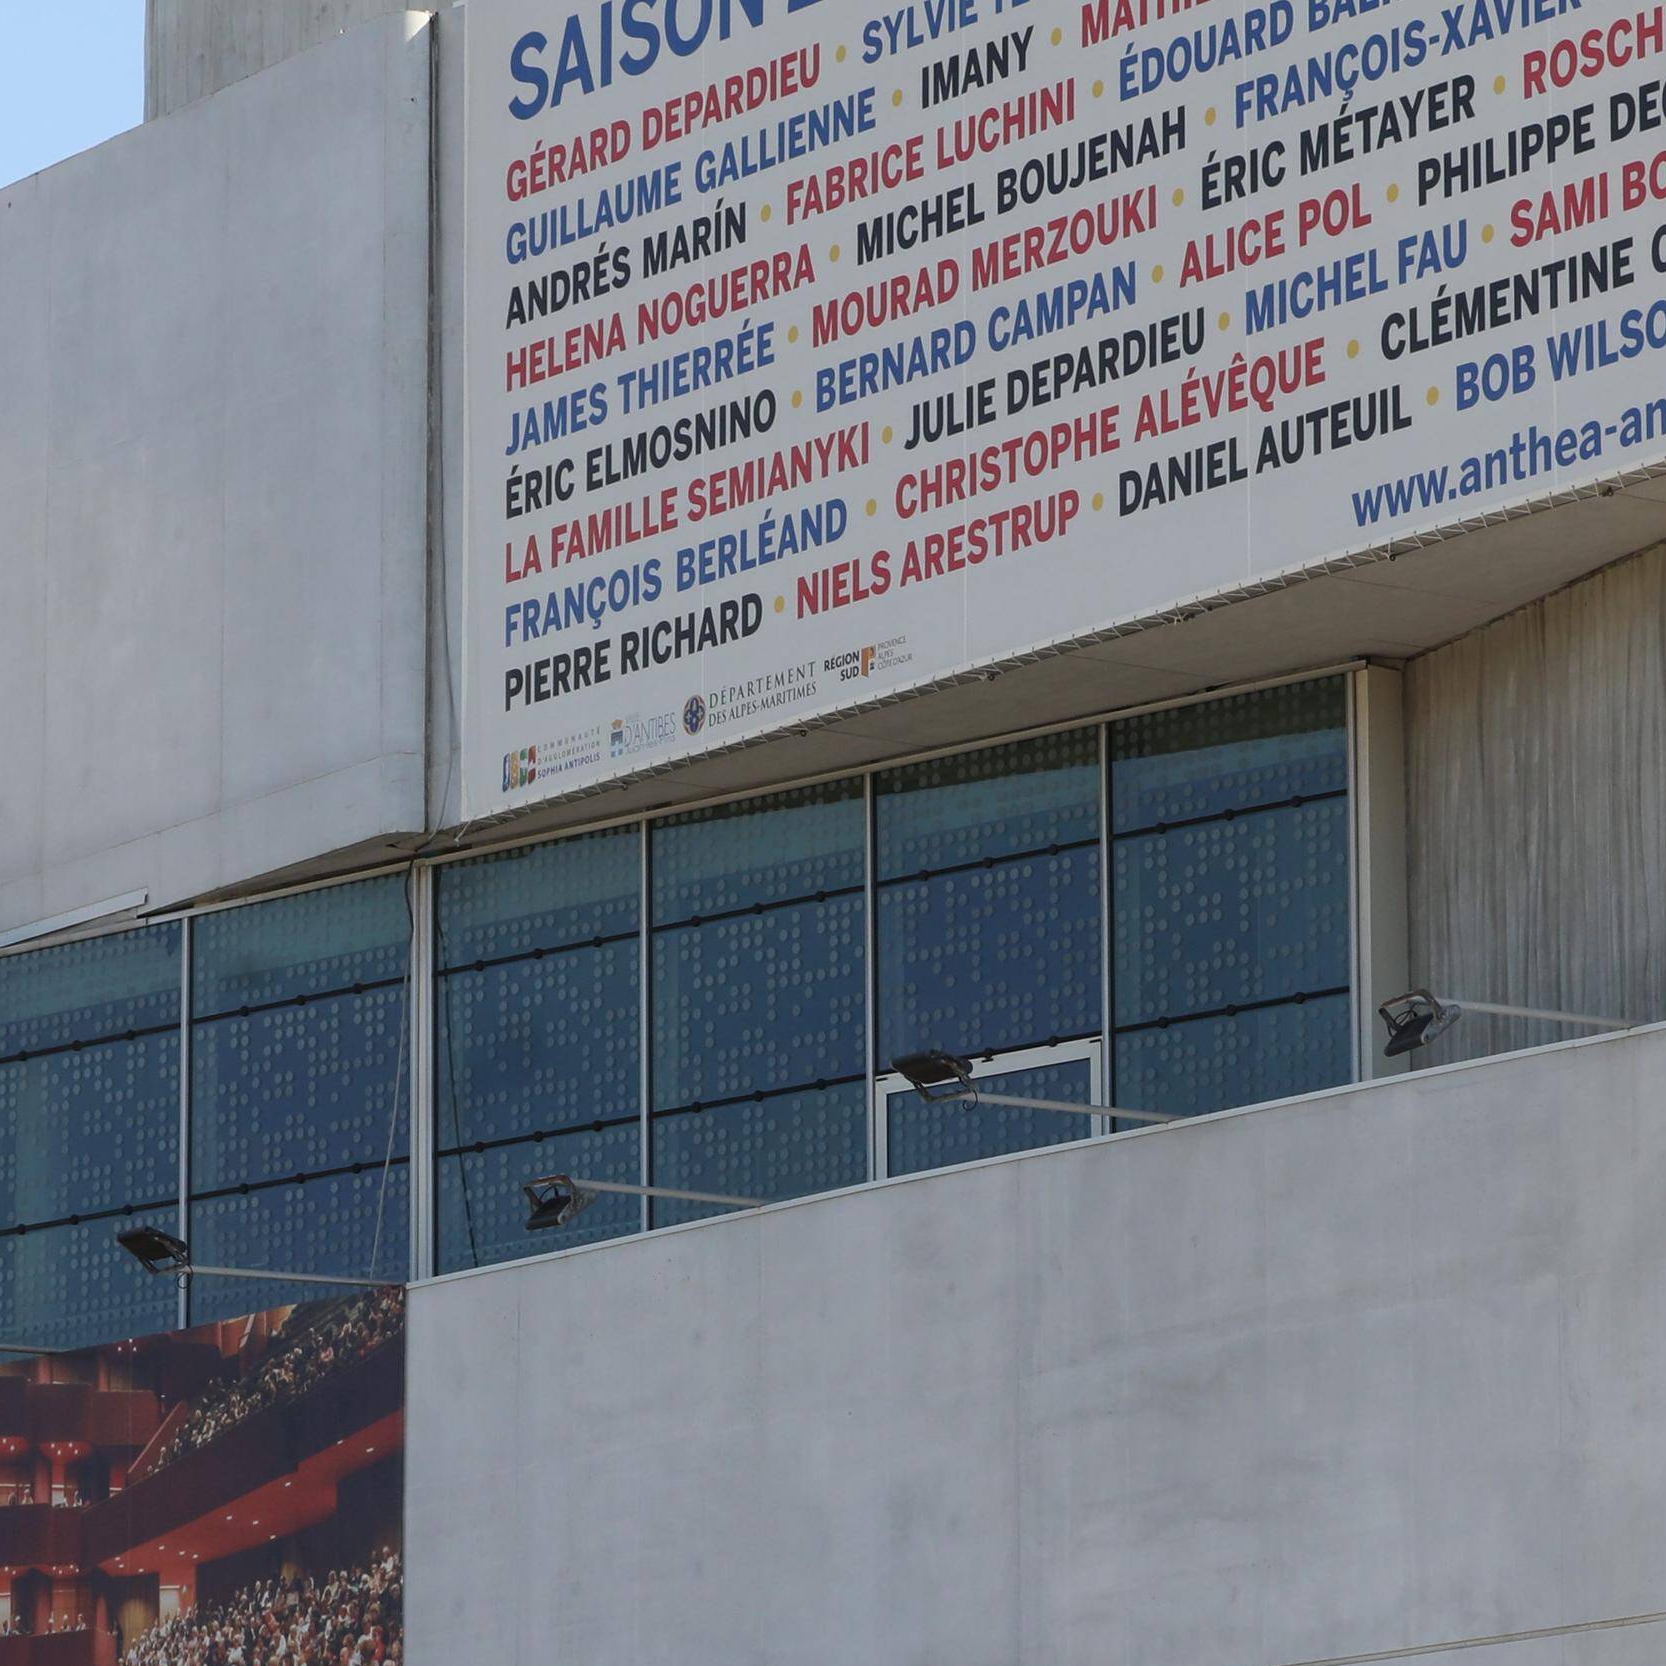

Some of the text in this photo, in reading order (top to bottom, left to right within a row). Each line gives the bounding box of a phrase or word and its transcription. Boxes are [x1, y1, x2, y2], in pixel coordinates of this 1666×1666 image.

[505, 240, 632, 330] ANDRÉS
[642, 196, 747, 280] MARÍN
[786, 134, 925, 226] FABRICE
[936, 77, 1075, 171] LUCHINI
[1119, 0, 1294, 103] ÉDOUARD
[506, 0, 979, 202] GÉRARD DEPARDIEU SYLVIE
[506, 160, 682, 265] GUILLAUME
[694, 86, 877, 194] GALLIENNE
[921, 24, 1035, 110] IMANY
[505, 382, 609, 457] JAMES
[616, 317, 775, 416] THIERRÉE
[812, 258, 960, 349] MOURAD
[971, 184, 1157, 293] MERZOUKI
[1201, 140, 1287, 212] ÉRIC
[1299, 74, 1476, 177] MÉTAYER
[505, 457, 575, 520] ÉRIC
[586, 388, 777, 493] ELMOSNINO
[816, 319, 977, 414] BERNARD
[987, 260, 1136, 353] CAMPAN
[1179, 208, 1286, 289] ALICE
[1298, 182, 1372, 248] POL
[1417, 102, 1596, 208] PHILIPPE
[505, 534, 543, 584] LA
[551, 486, 679, 569] FAMILLE
[686, 420, 869, 522] SEMIANYKI
[903, 377, 997, 451] JULIE
[1006, 306, 1205, 416] DEPARDIEU
[1245, 248, 1389, 336] MICHEL
[1397, 218, 1468, 286] FAU
[1509, 171, 1609, 248] SAMI
[506, 312, 627, 393] HELENA
[637, 243, 816, 346] NOGUERRA
[856, 181, 986, 267] MICHEL
[996, 104, 1186, 216] BOUJENAH
[505, 558, 663, 648] FRANÇOIS
[676, 497, 848, 593] BERLÉAND
[895, 404, 1121, 520] CHRISTOPHE
[1133, 336, 1326, 443] ALÉVÊQUE
[1380, 236, 1635, 361] CLÉMENTINE
[505, 638, 612, 713] PIERRE
[620, 592, 763, 676] RICHARD
[797, 550, 892, 620] NIELS
[899, 489, 1080, 588] ARESTRUP
[1118, 436, 1249, 518] DANIEL
[1255, 384, 1413, 475] AUTEUIL
[1455, 344, 1536, 412] BOB
[537, 751, 601, 780] SOPHIA ANTIPOLIS
[708, 660, 816, 709] DÉPARTEMENT
[708, 681, 817, 727] DES ALPES-MARITIMES
[839, 665, 860, 682] SUD
